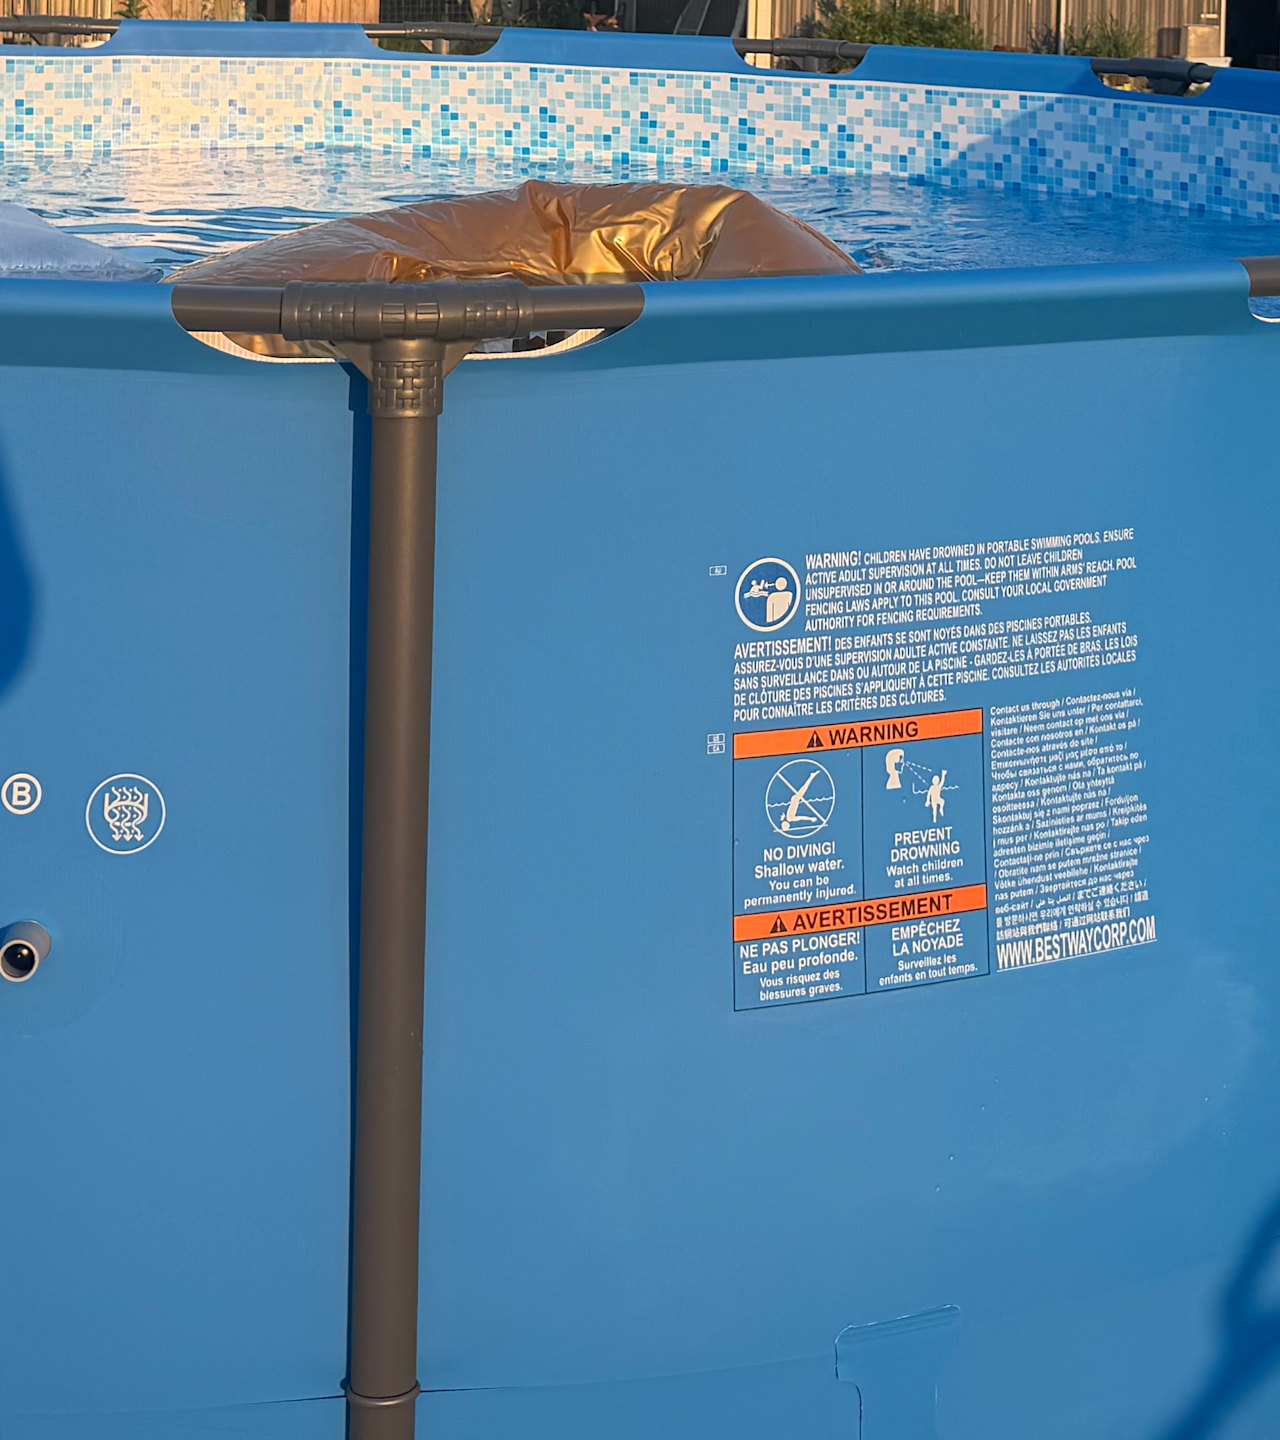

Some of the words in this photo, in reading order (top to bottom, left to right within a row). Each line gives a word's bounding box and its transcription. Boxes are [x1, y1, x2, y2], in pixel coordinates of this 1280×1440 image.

[806, 551, 861, 569] WARNING!
[863, 550, 906, 565] CHILDREN
[908, 548, 930, 561] HAVE
[933, 544, 974, 559] DROWNED
[976, 543, 984, 555] IN
[987, 539, 1028, 554] PORTABLE
[1031, 535, 1071, 550] SWIMMING
[1073, 532, 1101, 546] POOLS.
[1103, 529, 1134, 543] ENSURE
[805, 571, 836, 585] ACTIVE
[838, 569, 866, 582] ADULT
[868, 564, 924, 580] SUPERVISION
[926, 563, 936, 575] AT
[938, 561, 954, 574] ALL
[956, 558, 982, 572] TIMES.
[984, 557, 996, 569] DO
[998, 555, 1014, 568] NOT
[1017, 552, 1041, 566] LEAVE
[1043, 548, 1082, 563] CHILDREN
[805, 583, 871, 600] UNSUPERVISED
[873, 582, 882, 594] IN
[884, 581, 896, 593] OR
[898, 577, 934, 592] AROUND
[937, 576, 952, 588] THE
[1009, 568, 1030, 581] THEM
[1032, 565, 1058, 579] WITHIN
[1086, 559, 1114, 573] REACH.
[1116, 556, 1136, 570] POOL
[805, 602, 843, 616] FENCING
[845, 599, 870, 613] LAWS
[871, 597, 898, 610] APPLY
[901, 595, 912, 608] TO
[915, 593, 932, 606] THIS
[934, 591, 959, 604] POOL.
[961, 587, 999, 602] CONSULT
[1001, 584, 1023, 598] YOUR
[1025, 581, 1052, 595] LOCAL
[1054, 575, 1106, 592] GOVERNMENT
[805, 615, 854, 631] AUTHORITY
[856, 613, 874, 626] FOR
[876, 609, 913, 624] FENCING
[915, 602, 982, 620] REQUIREMENTS.
[734, 637, 832, 659] AVERTISSEMENT!
[835, 637, 852, 649] DES
[854, 633, 893, 648] ENFANTS
[895, 632, 906, 644] SE
[908, 629, 931, 642] SONT
[933, 626, 961, 640] NOYÉS
[963, 623, 986, 636] DANS
[988, 621, 1004, 634] DES
[1006, 617, 1042, 632] PISCINES
[1044, 612, 1092, 628] PORTABLES.
[734, 657, 803, 674] ASSUREZ-VOUS
[834, 648, 891, 665] SUPERVISION
[893, 644, 926, 659] ADULTE
[928, 641, 957, 655] ACTIVE
[960, 636, 1009, 652] CONSTANTE.
[1012, 634, 1022, 646] NE
[1025, 630, 1057, 645] LAISSEZ
[1059, 628, 1074, 641] PAS
[1076, 626, 1090, 639] LES
[1092, 622, 1126, 637] ENFANTS
[734, 677, 758, 690] SANS
[760, 670, 828, 688] SURVEILLANCE
[830, 667, 854, 681] DANS
[856, 666, 869, 678] OU
[871, 662, 906, 676] AUTOUR
[908, 660, 919, 672] DE
[922, 659, 933, 671] LA
[935, 655, 966, 670] PISCINE
[974, 648, 1024, 665] GARDEZ-LES
[1026, 646, 1032, 659] À
[1034, 643, 1065, 658] PORTÉE
[1067, 642, 1077, 654] DE
[1080, 639, 1103, 653] BRAS.
[1104, 637, 1118, 650] LES
[1120, 634, 1137, 648] LOIS
[734, 694, 745, 706] DE
[748, 689, 790, 705] CLÔTURE
[793, 687, 810, 700] DES
[813, 683, 853, 698] PISCINES
[919, 674, 924, 687] À
[927, 672, 953, 686] CETTE
[956, 668, 989, 683] PISCINE.
[992, 662, 1038, 678] CONSULTEZ
[1040, 660, 1055, 673] LES
[1057, 654, 1099, 671] AUTORITÉS
[1101, 650, 1136, 665] LOCALES
[734, 708, 759, 722] POUR
[762, 703, 813, 719] CONNAÎTRE
[815, 701, 832, 714] LES
[835, 697, 877, 712] CRITÈRES
[879, 695, 896, 708] DES
[899, 690, 946, 706] CLÔTURES.
[830, 721, 918, 745] WARNING
[895, 827, 953, 846] PREVENT
[764, 848, 784, 862] NO
[787, 841, 835, 860] DIVING!
[891, 841, 960, 862] DROWNING
[755, 864, 804, 879] Shallow
[809, 859, 844, 873] water.
[886, 865, 919, 877] Watch
[922, 858, 963, 873] children
[770, 880, 790, 891] You
[793, 879, 813, 889] can
[816, 876, 829, 886] be
[895, 879, 904, 888] at
[907, 876, 919, 886] all
[923, 872, 953, 884] times.
[744, 889, 813, 909] permanently
[816, 885, 856, 901] injured.
[793, 894, 953, 931] AVERTISSEMENT
[892, 919, 960, 940] EMPÊCHEZ
[740, 944, 758, 959] NE
[763, 942, 788, 956] PAS
[792, 932, 860, 953] PLONGER!
[893, 943, 909, 957] LA
[912, 934, 963, 954] NOYADE
[997, 915, 1156, 969] WWW.BESTWAYCORP.COM
[743, 960, 767, 975] Eau
[771, 958, 795, 975] peu
[799, 951, 858, 970] profonde.
[879, 971, 913, 986] enfants
[916, 971, 926, 980] en
[928, 967, 946, 978] tout
[949, 963, 978, 978] temps.
[898, 956, 942, 972] Surveillez
[944, 954, 957, 965] les
[760, 976, 783, 988] Vous
[787, 972, 821, 987] risquez
[823, 969, 840, 980] des
[760, 987, 806, 1001] blessures
[809, 982, 843, 998] graves.
